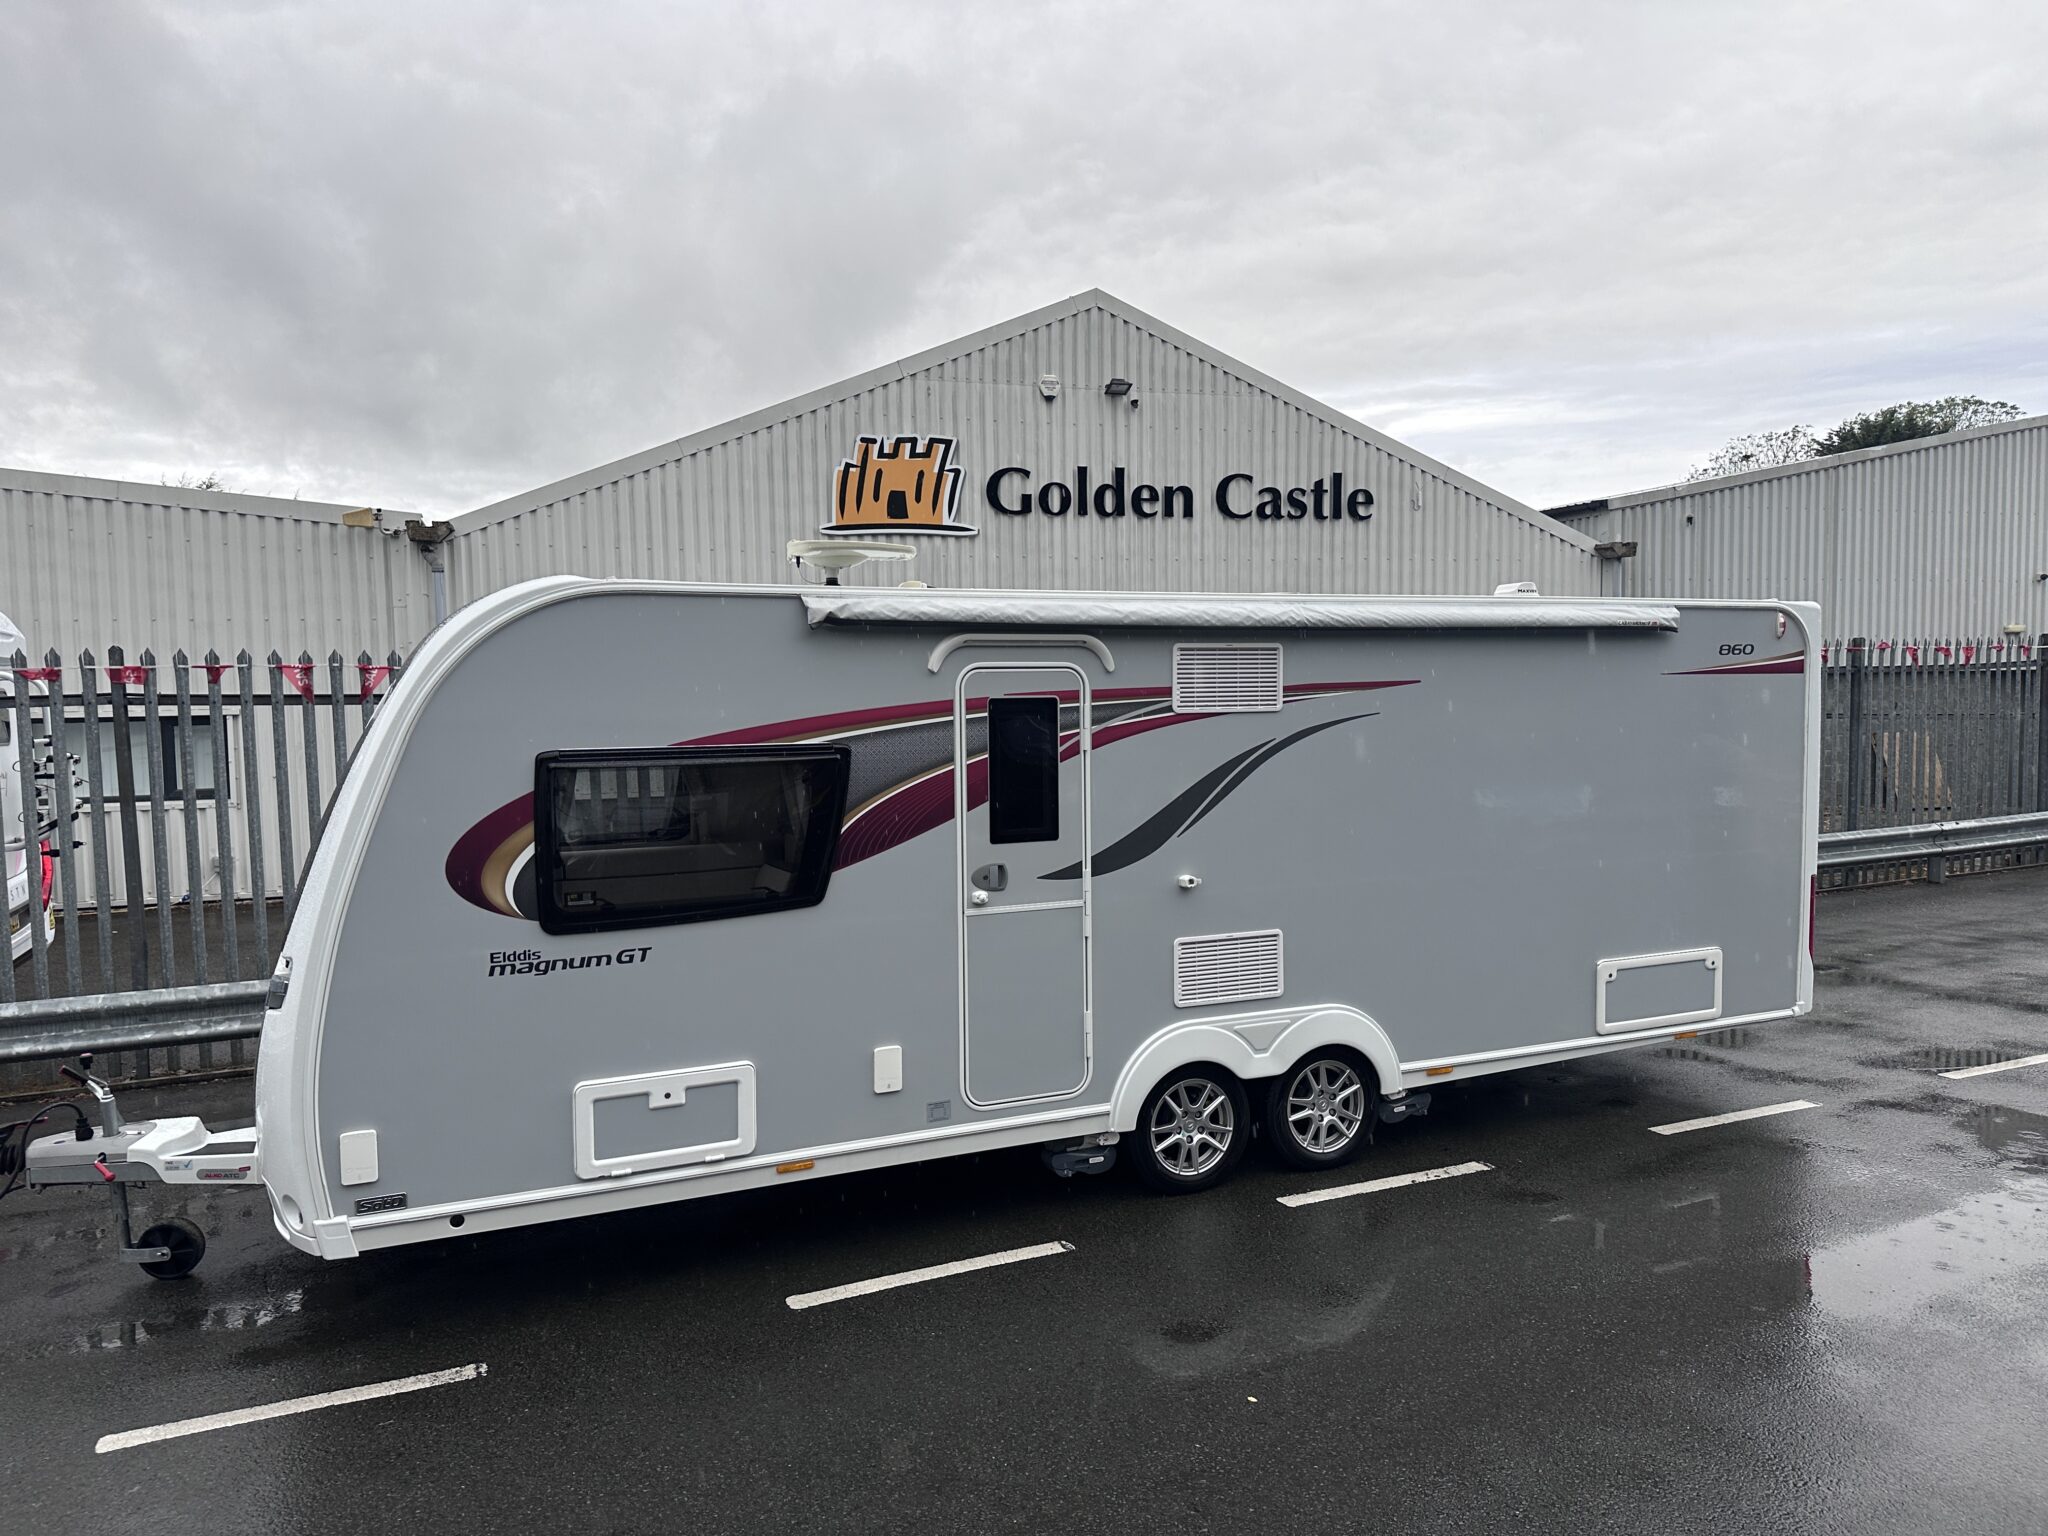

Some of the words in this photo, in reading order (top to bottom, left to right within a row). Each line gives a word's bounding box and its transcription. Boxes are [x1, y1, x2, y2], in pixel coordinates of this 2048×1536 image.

[985, 466, 1194, 519] Golden
[1215, 472, 1374, 521] Castle
[1718, 643, 1755, 656] 860
[488, 954, 612, 977] magnum
[615, 946, 653, 965] GT
[489, 949, 542, 964] Elddis
